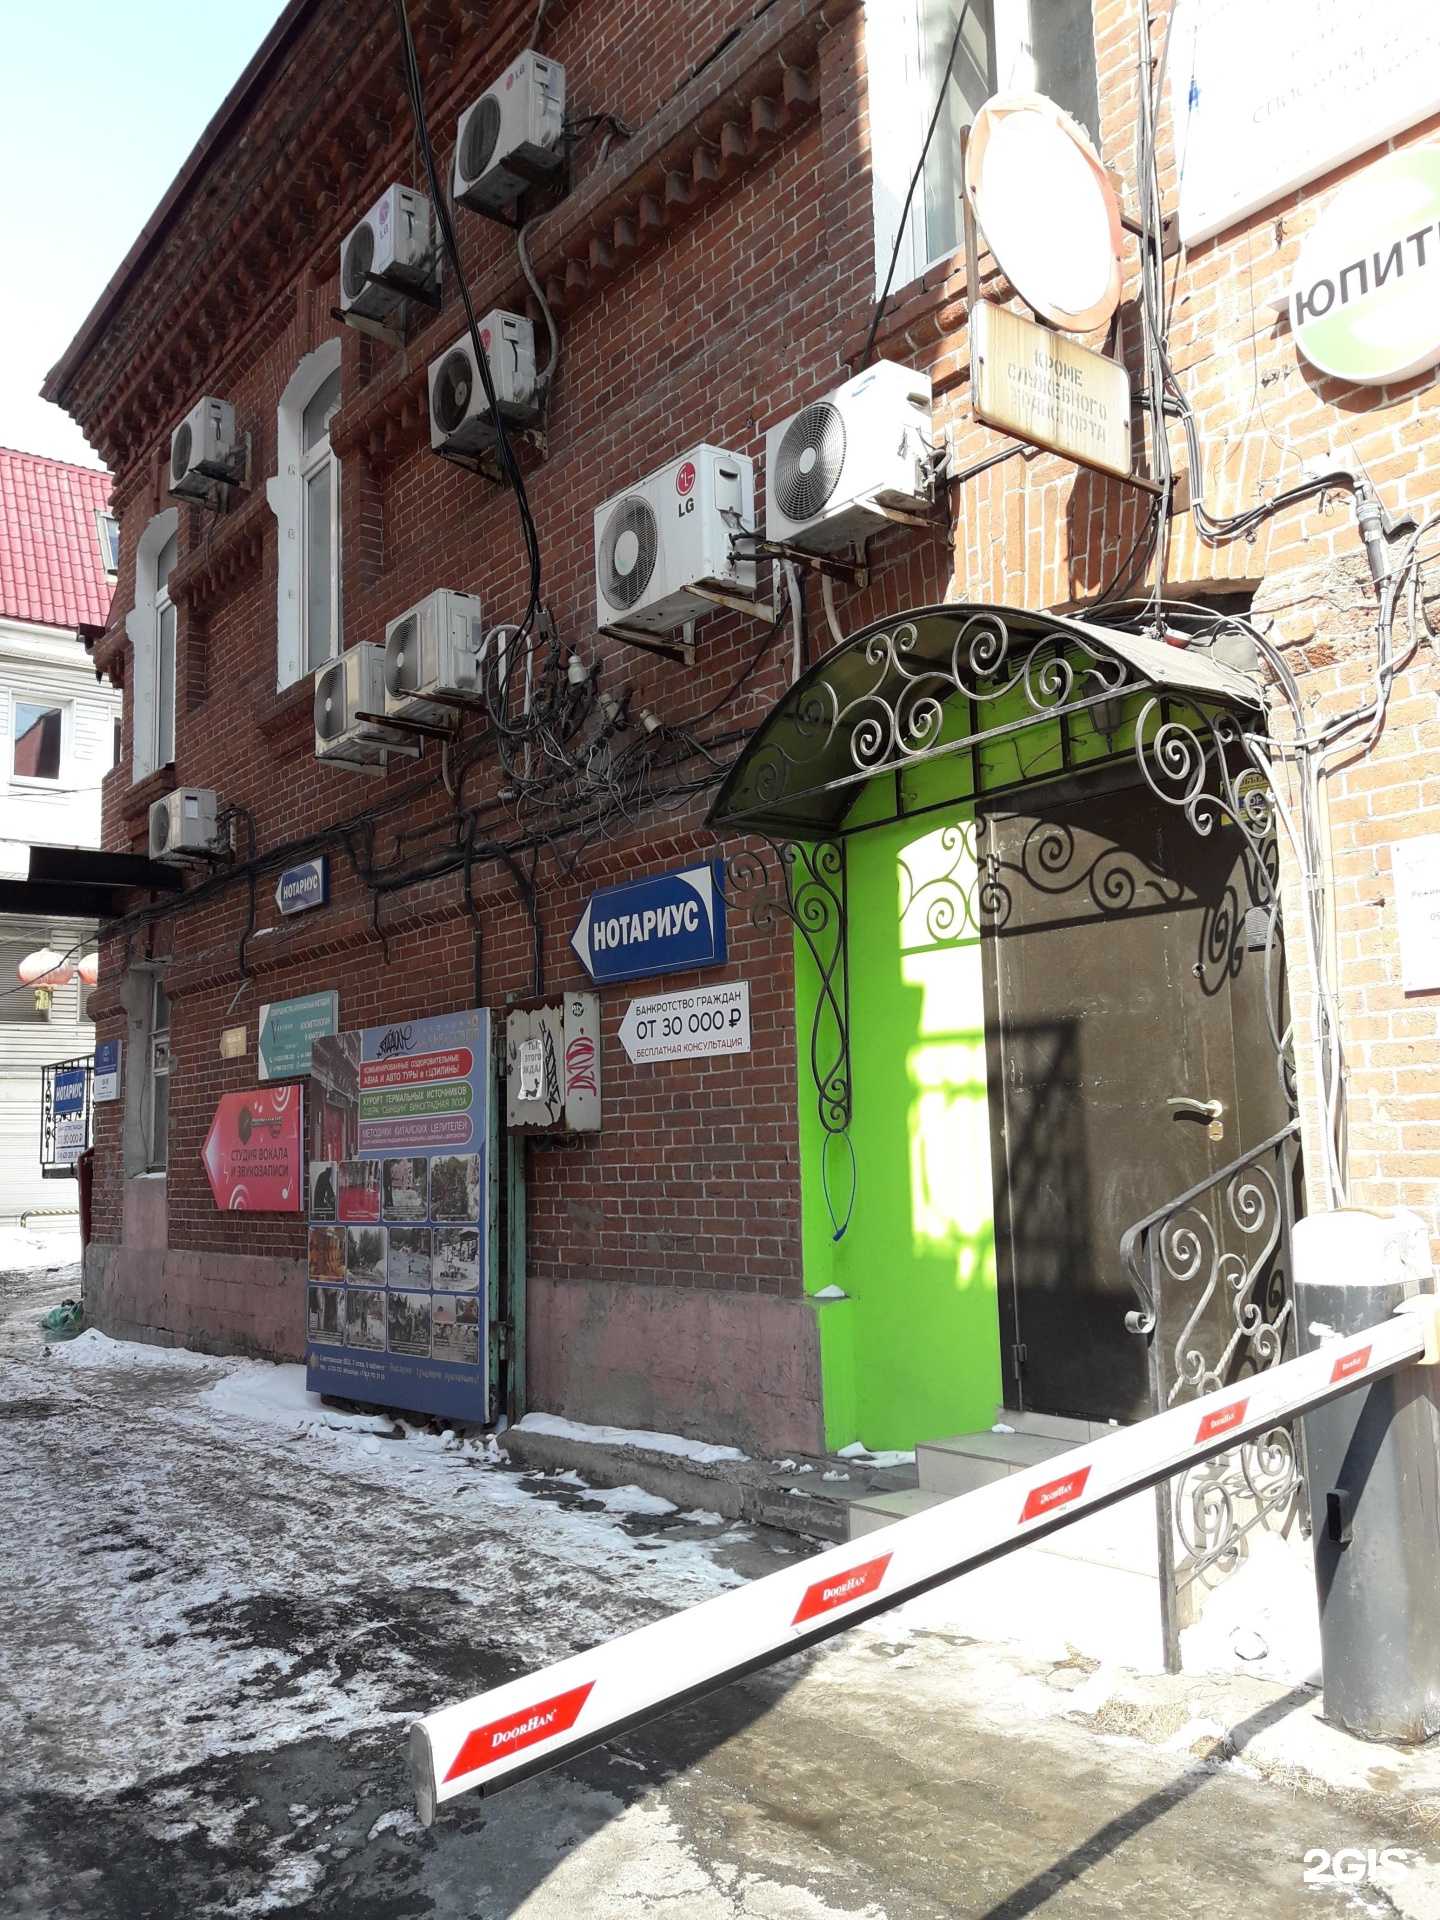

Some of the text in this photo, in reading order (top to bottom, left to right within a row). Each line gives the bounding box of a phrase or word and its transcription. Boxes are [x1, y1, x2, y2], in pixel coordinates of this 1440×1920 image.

[1296, 222, 1440, 326] ЮПИТ
[1034, 348, 1083, 387] КРОМЕ
[1008, 363, 1107, 421] СЛУЖЕБНОГО
[678, 497, 694, 517] LG
[283, 875, 318, 900] НОТАРИУС
[593, 900, 699, 951] НОТАРИУС
[635, 991, 741, 1016] БАНКРОТСТВО ГРАЖДАН
[636, 1008, 742, 1040] ОТ 30 000 ₽
[636, 1037, 742, 1058] БЕСПЛАТНАЯ КОНСУЛЬТАЦИЯ
[402, 1070, 418, 1080] ТУРЫ
[56, 1083, 83, 1101] НОТАРИУС
[231, 1147, 288, 1161] СТУДИЯ ВОКАЛА
[236, 1164, 289, 1178] ЗВУКОЗАПИСИ
